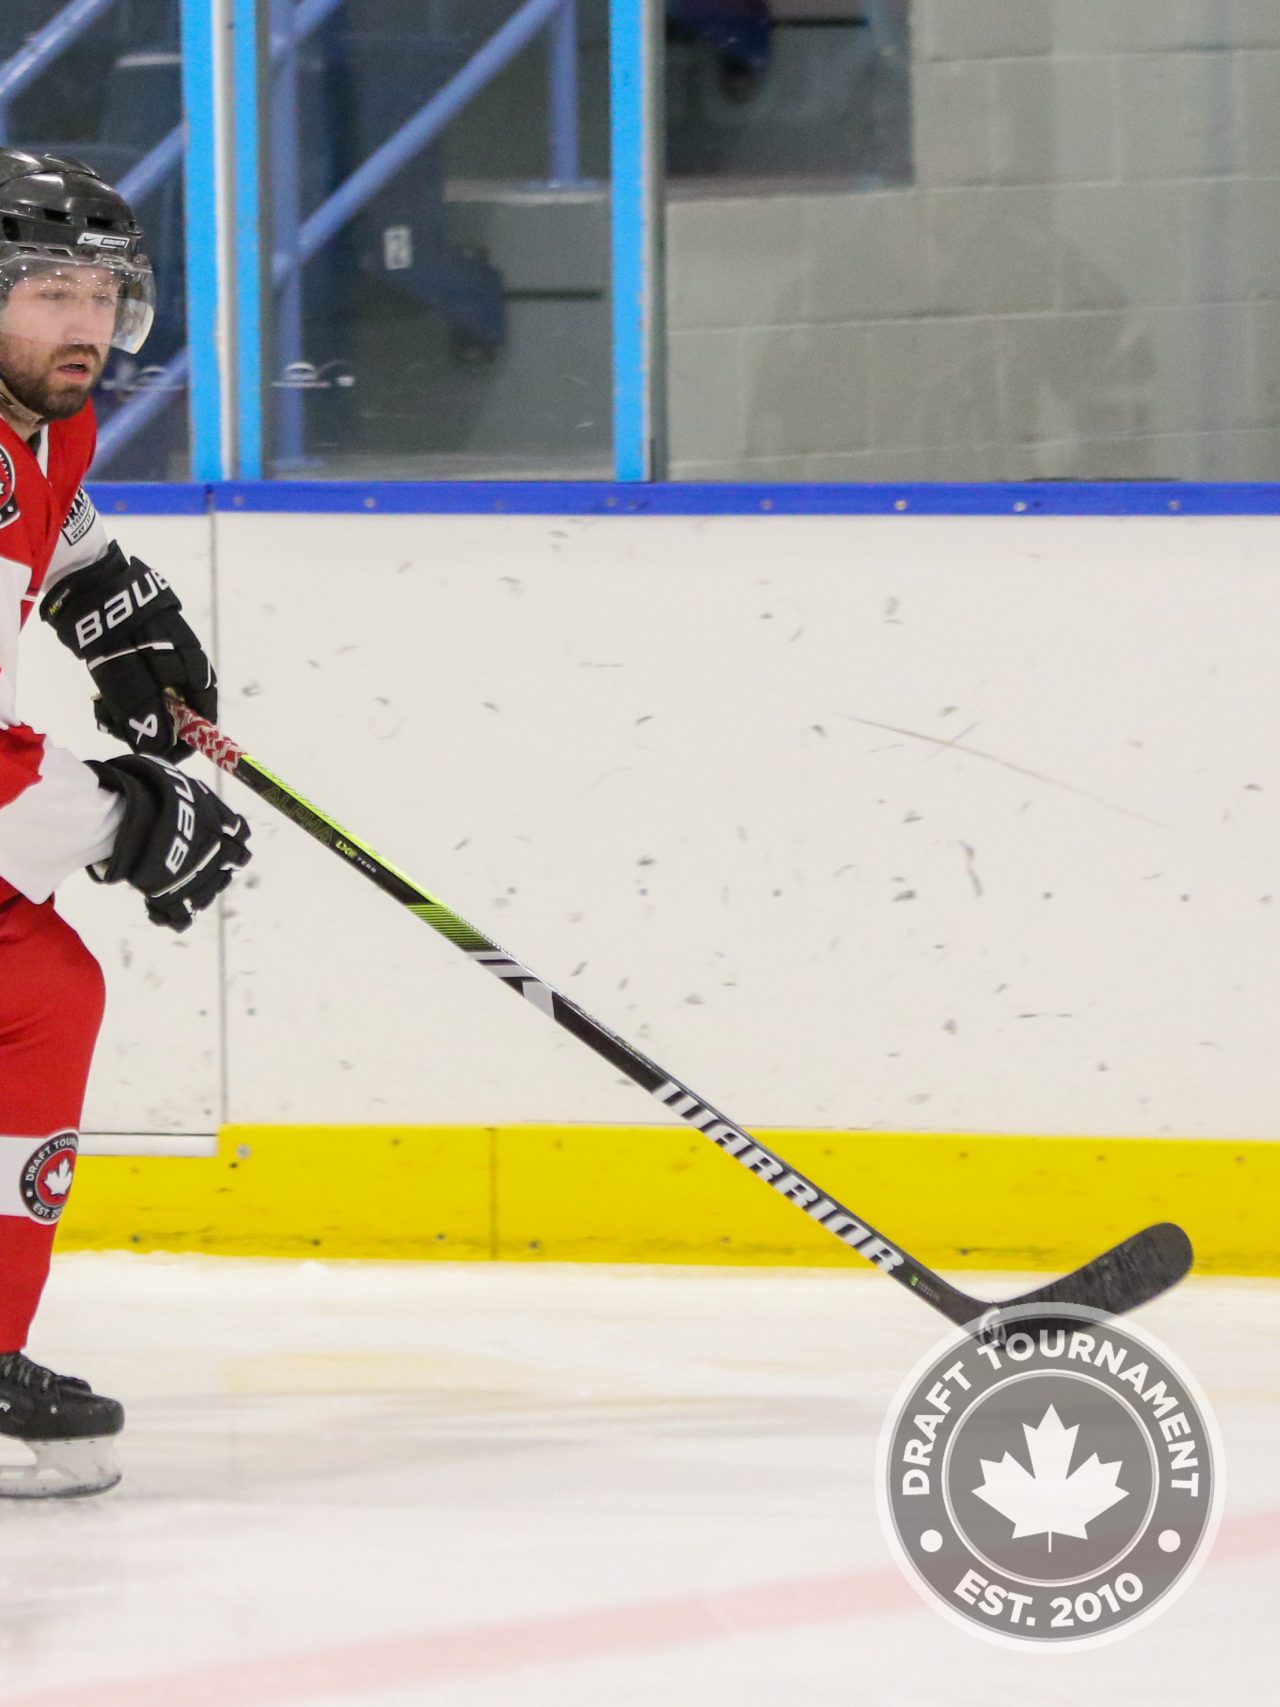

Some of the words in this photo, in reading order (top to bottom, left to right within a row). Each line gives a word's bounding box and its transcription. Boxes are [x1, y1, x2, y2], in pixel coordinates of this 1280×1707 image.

[24, 1145, 52, 1182] DRAFT
[652, 1080, 905, 1273] WARRIOR
[32, 1202, 51, 1219] EST.
